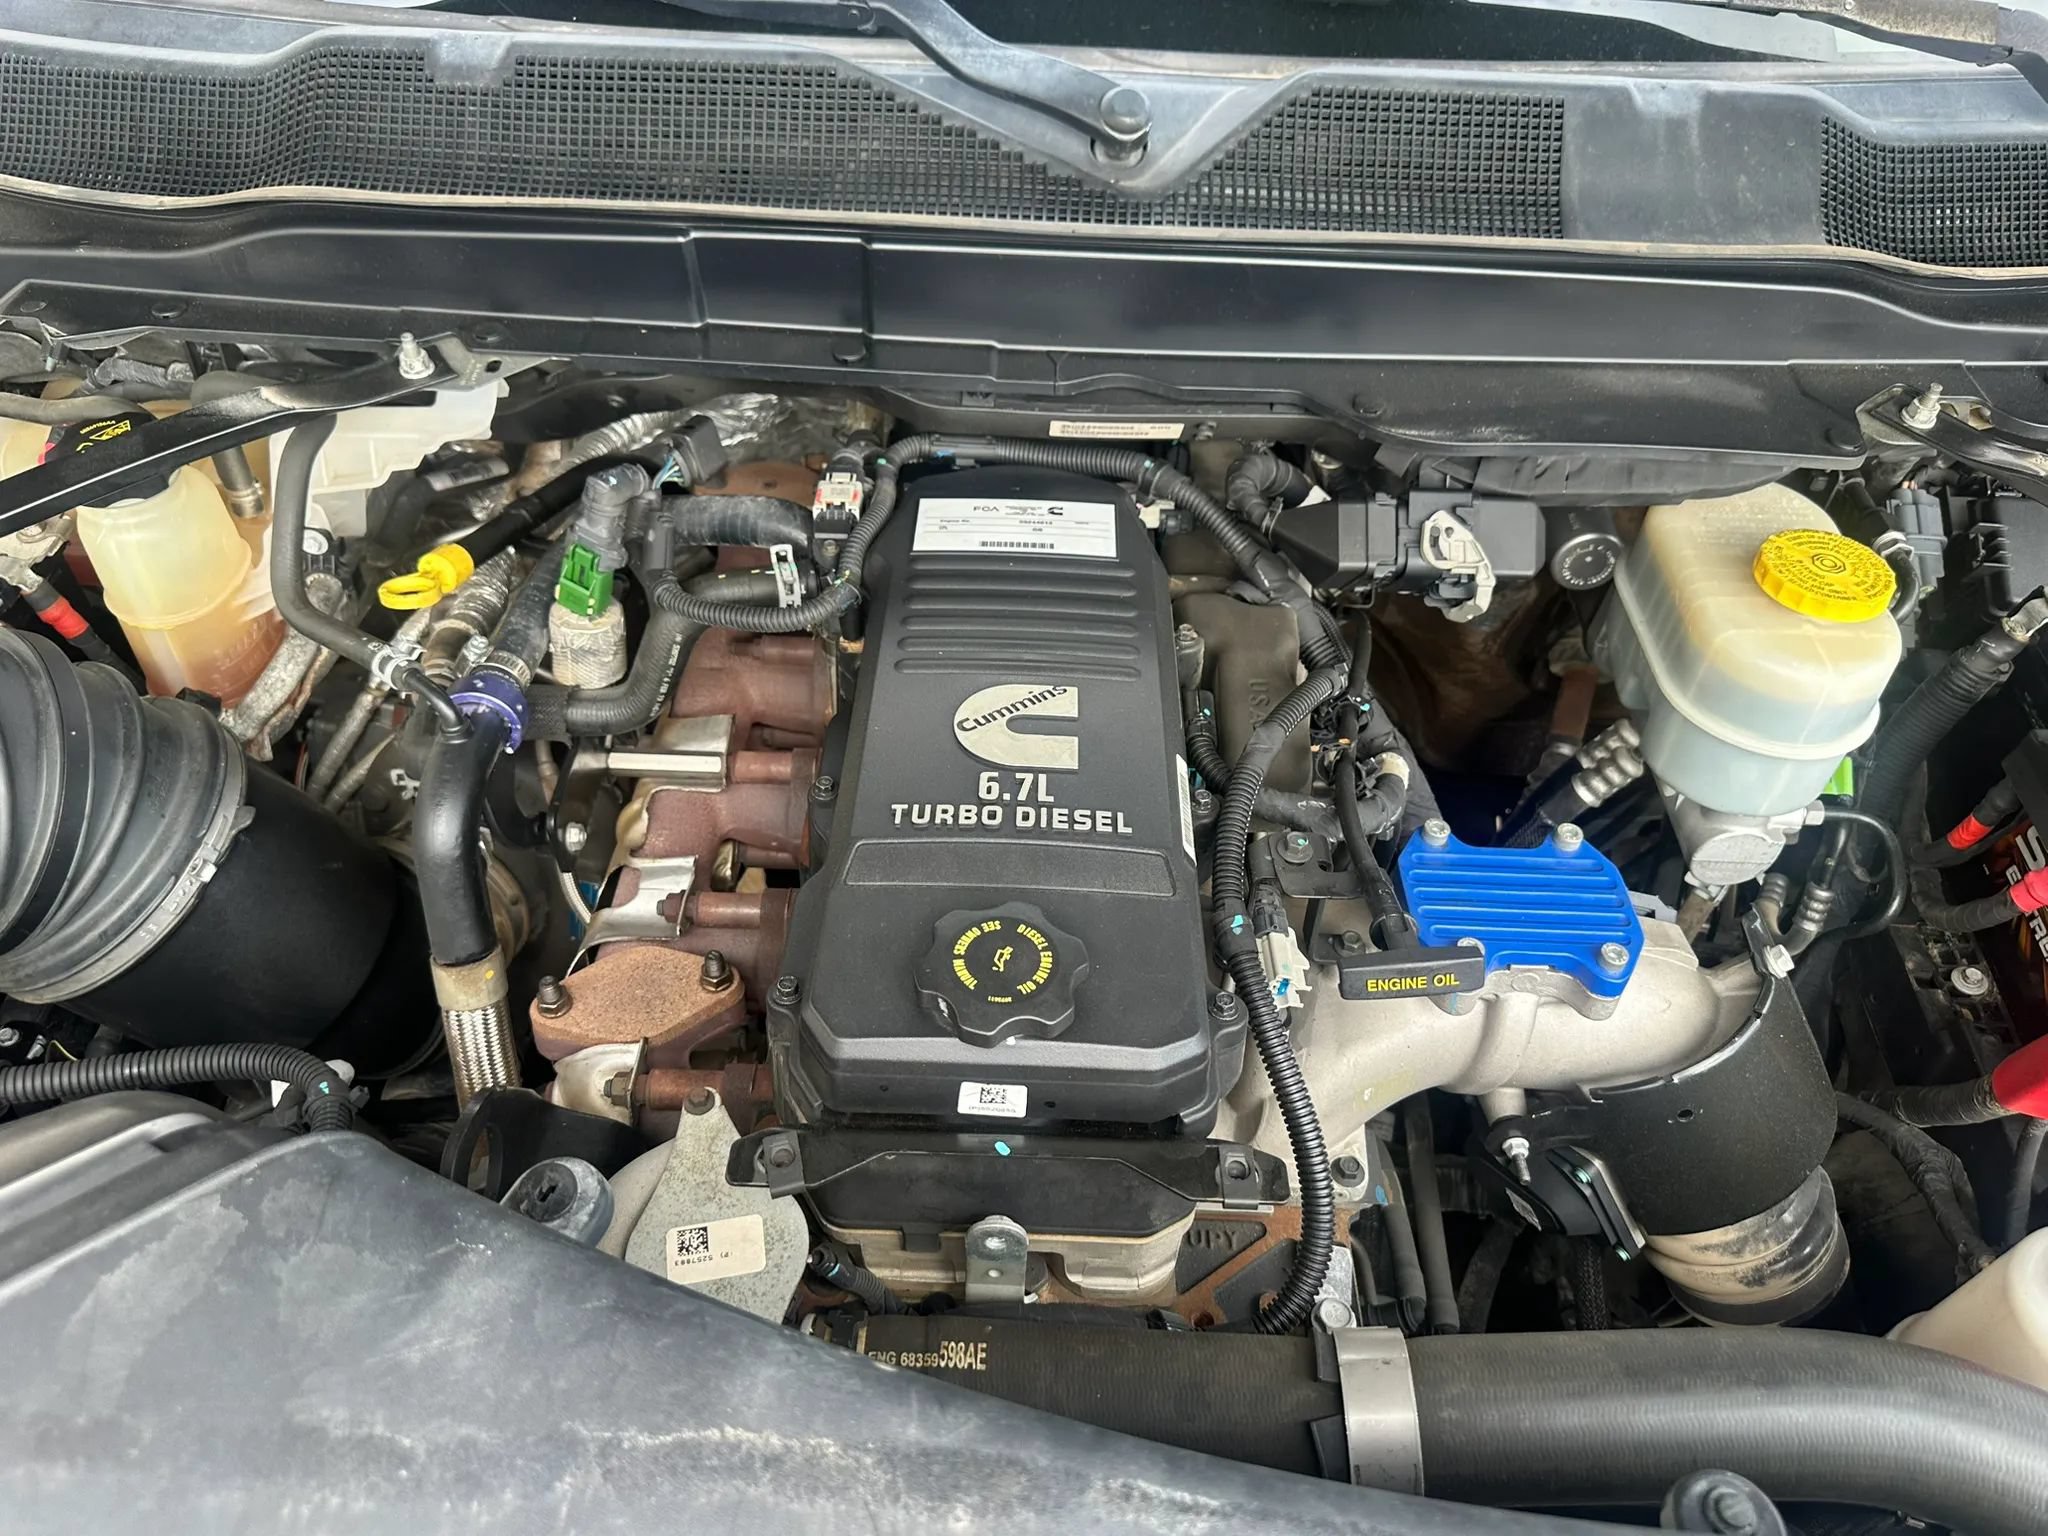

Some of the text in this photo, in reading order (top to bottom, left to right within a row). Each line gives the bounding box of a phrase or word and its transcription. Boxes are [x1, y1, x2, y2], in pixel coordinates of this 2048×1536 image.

[957, 685, 1068, 732] Cummins
[978, 771, 1055, 803] 6.7L
[891, 803, 1133, 835] TURBO DIESEL
[981, 920, 1001, 932] SEE
[1016, 923, 1053, 995] DIESEL ENGINE OIL
[1367, 973, 1460, 992] ENGINE OIL
